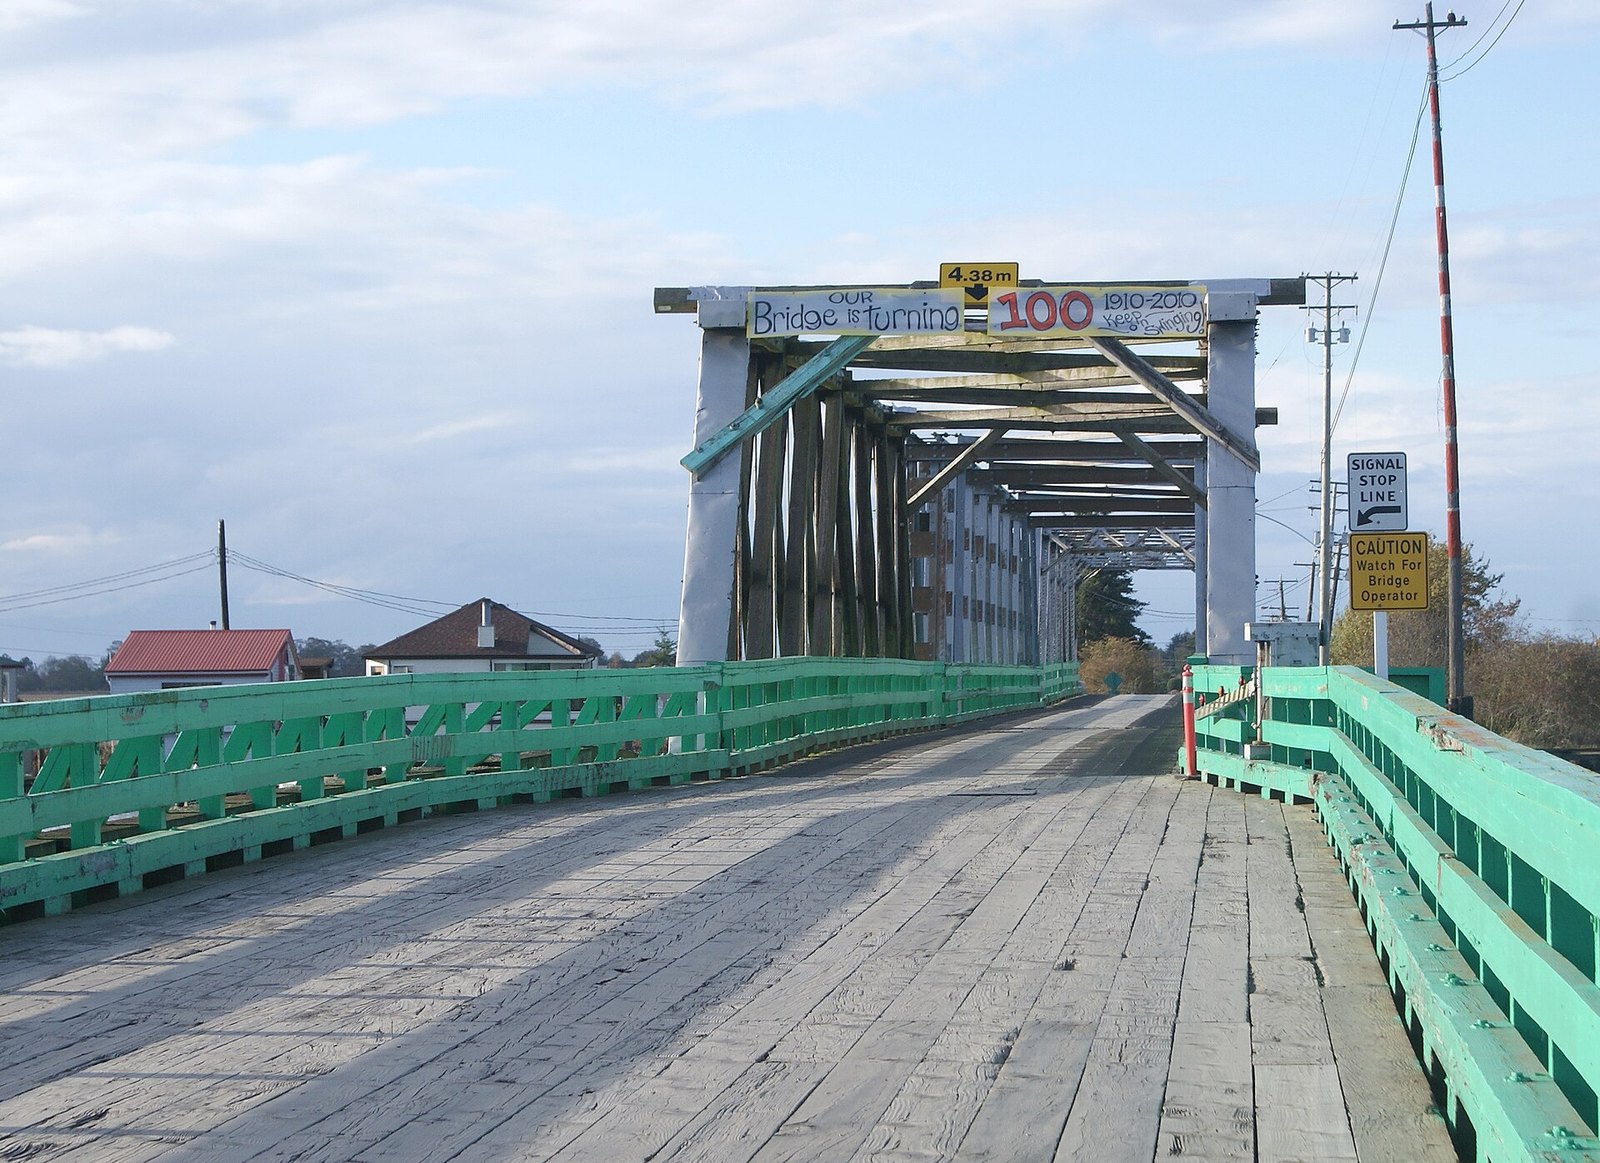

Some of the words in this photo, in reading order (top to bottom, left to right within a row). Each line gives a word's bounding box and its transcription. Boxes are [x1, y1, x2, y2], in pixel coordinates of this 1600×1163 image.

[948, 267, 992, 281] 4.38
[996, 272, 1011, 281] m
[829, 291, 873, 305] OUR
[1104, 292, 1197, 310] 1910-2010
[997, 290, 1094, 331] 100
[754, 301, 838, 334] Bridge
[848, 308, 861, 324] is
[863, 302, 959, 331] turning
[1352, 458, 1404, 470] SIGNAL
[1359, 474, 1397, 486] STOP
[1360, 490, 1396, 502] LINE
[1356, 539, 1422, 555] CAUTION
[1357, 560, 1395, 571] Watch
[1402, 559, 1421, 571] For
[1369, 575, 1410, 588] Bridge
[1361, 590, 1418, 603] Operator
